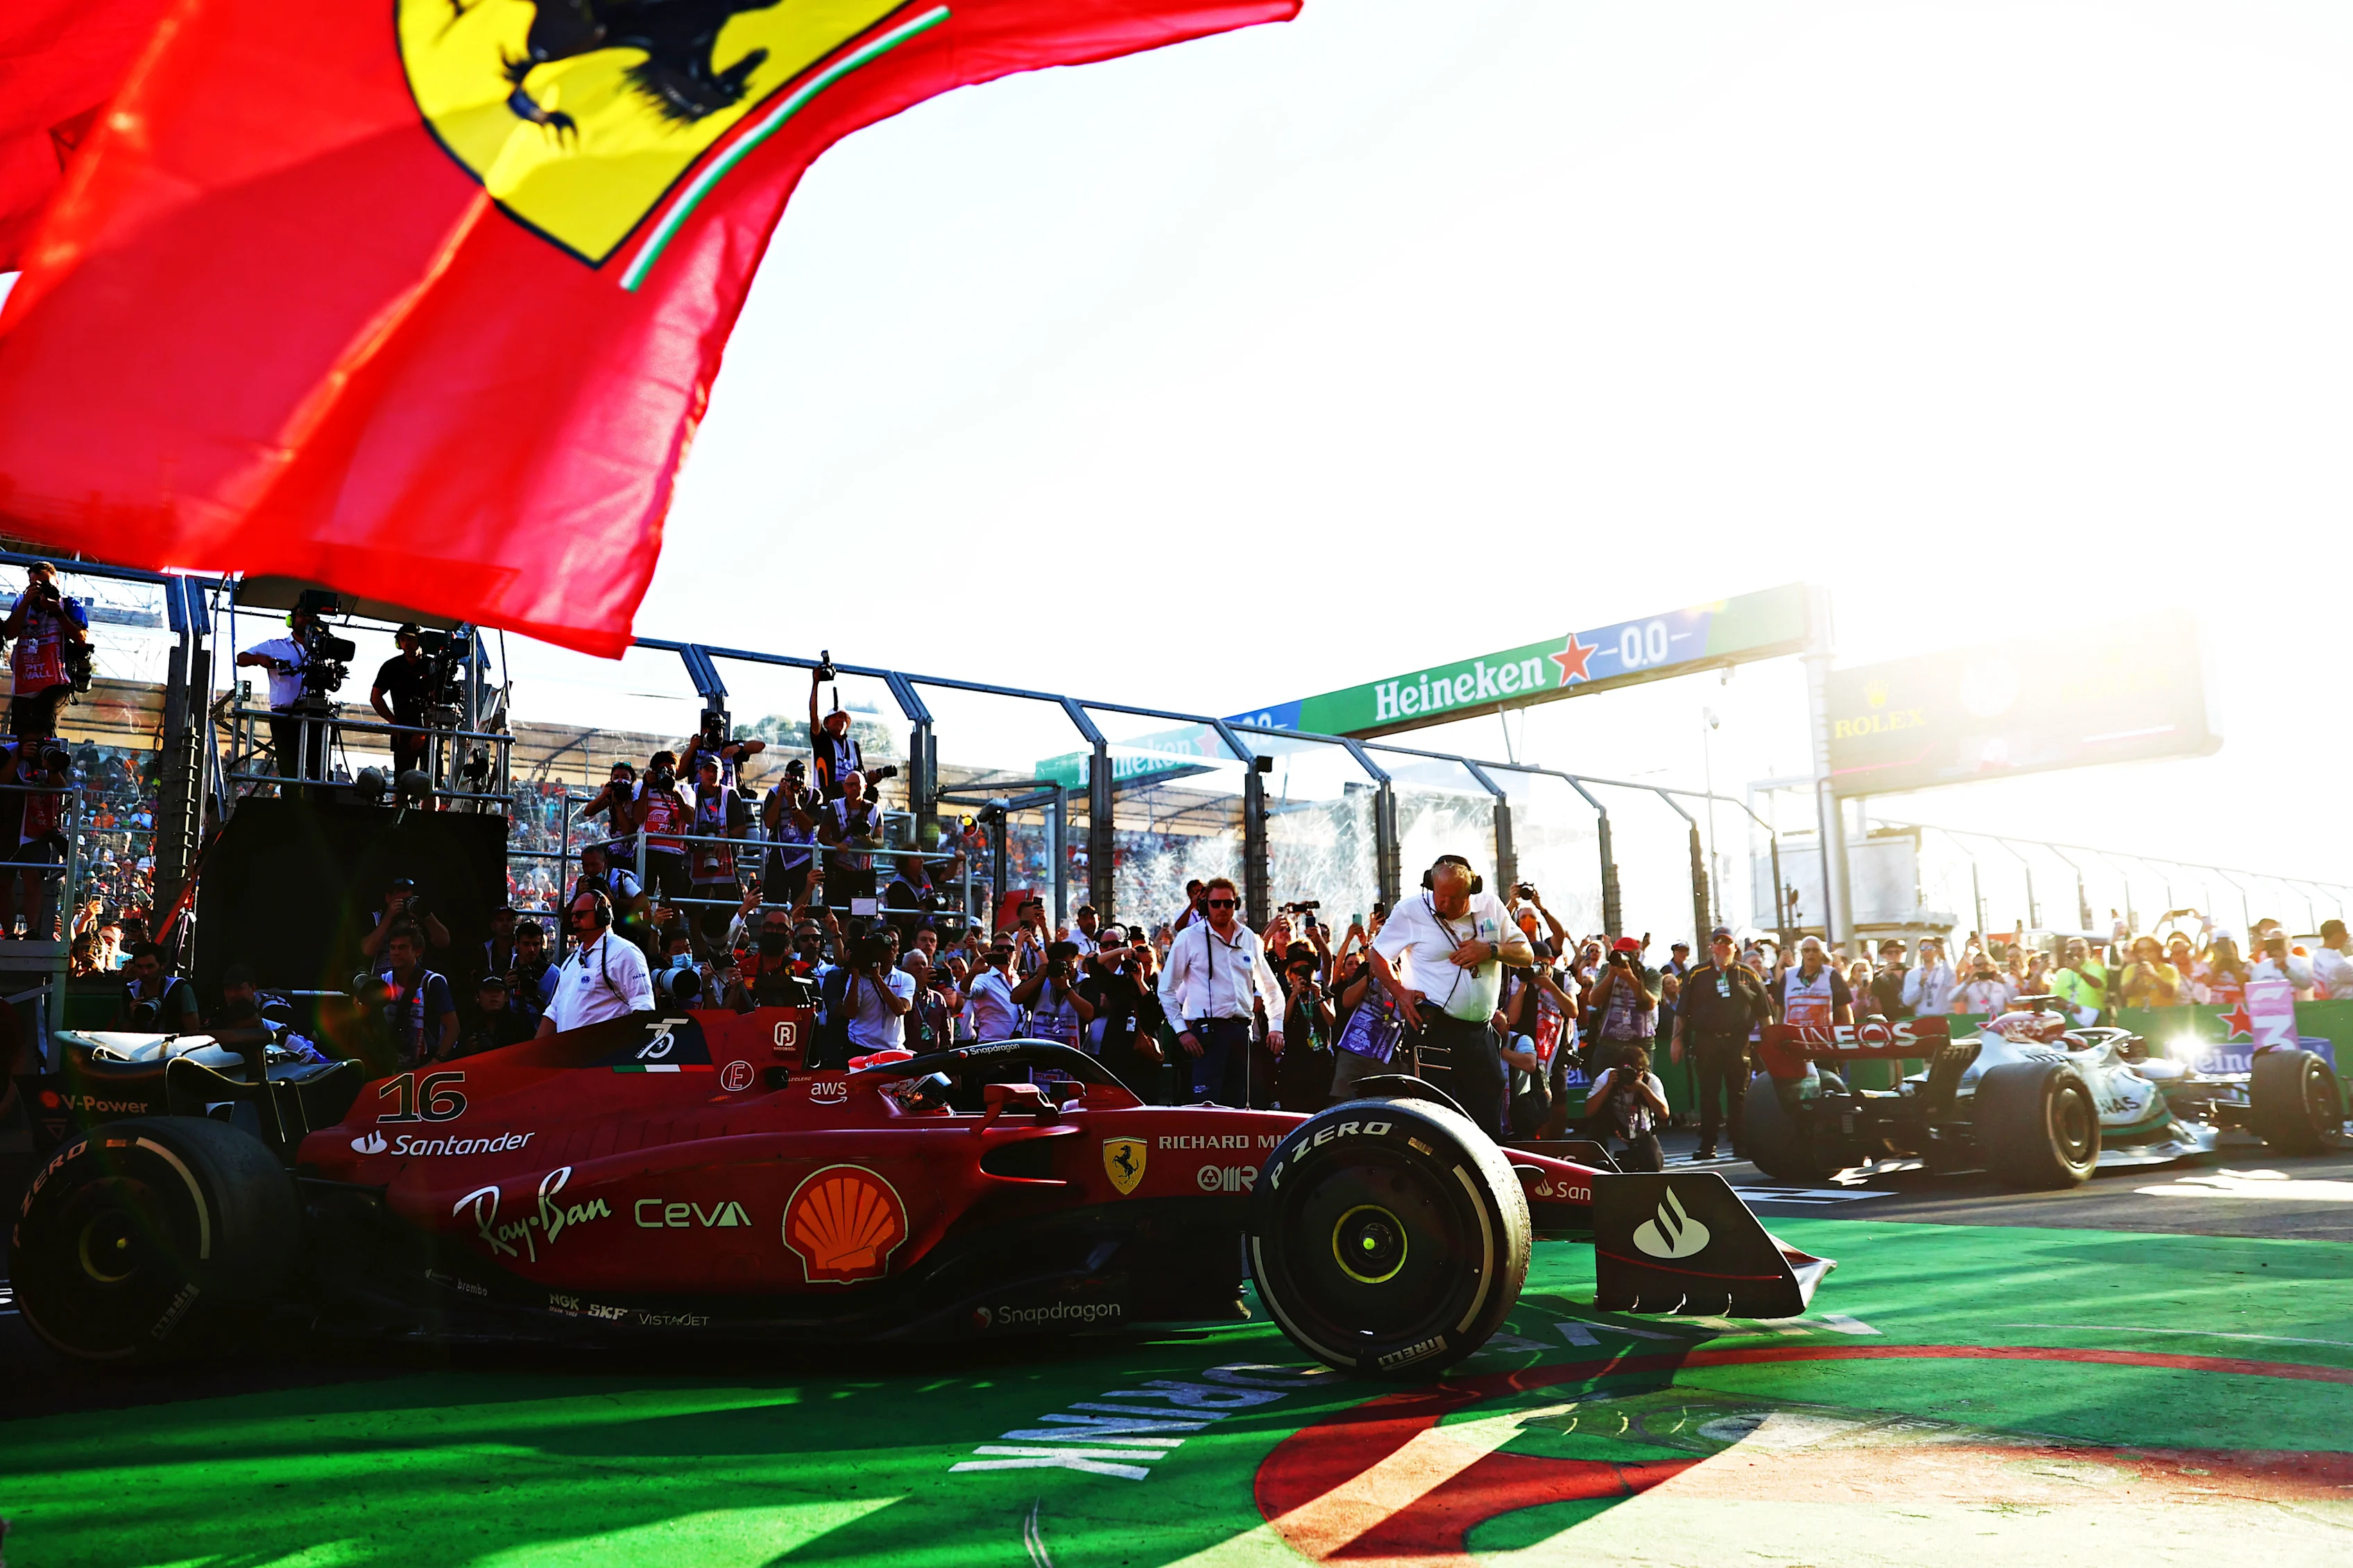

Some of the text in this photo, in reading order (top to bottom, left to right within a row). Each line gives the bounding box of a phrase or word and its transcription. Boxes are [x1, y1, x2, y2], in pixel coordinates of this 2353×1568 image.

[1374, 656, 1546, 721] Heineken
[1834, 707, 1927, 740] ROLEX
[970, 1042, 1020, 1056] Snapdragon
[1797, 1022, 1918, 1051] INEOS
[376, 1071, 468, 1123] 16
[810, 1082, 847, 1096] aws
[60, 1094, 148, 1114] V-Power
[391, 1132, 536, 1156] Santander
[1158, 1135, 1249, 1149] RICHARD
[1271, 1161, 1284, 1190] P
[1291, 1121, 1393, 1163] ZERO
[20, 1139, 92, 1218] ZERO
[456, 1277, 488, 1297] brembo
[548, 1293, 580, 1311] NGK
[587, 1303, 629, 1320] SKF
[998, 1300, 1122, 1325] Snapdragon
[1465, 1313, 1883, 1358] NEVE
[1376, 1334, 1448, 1372] PIRELLI
